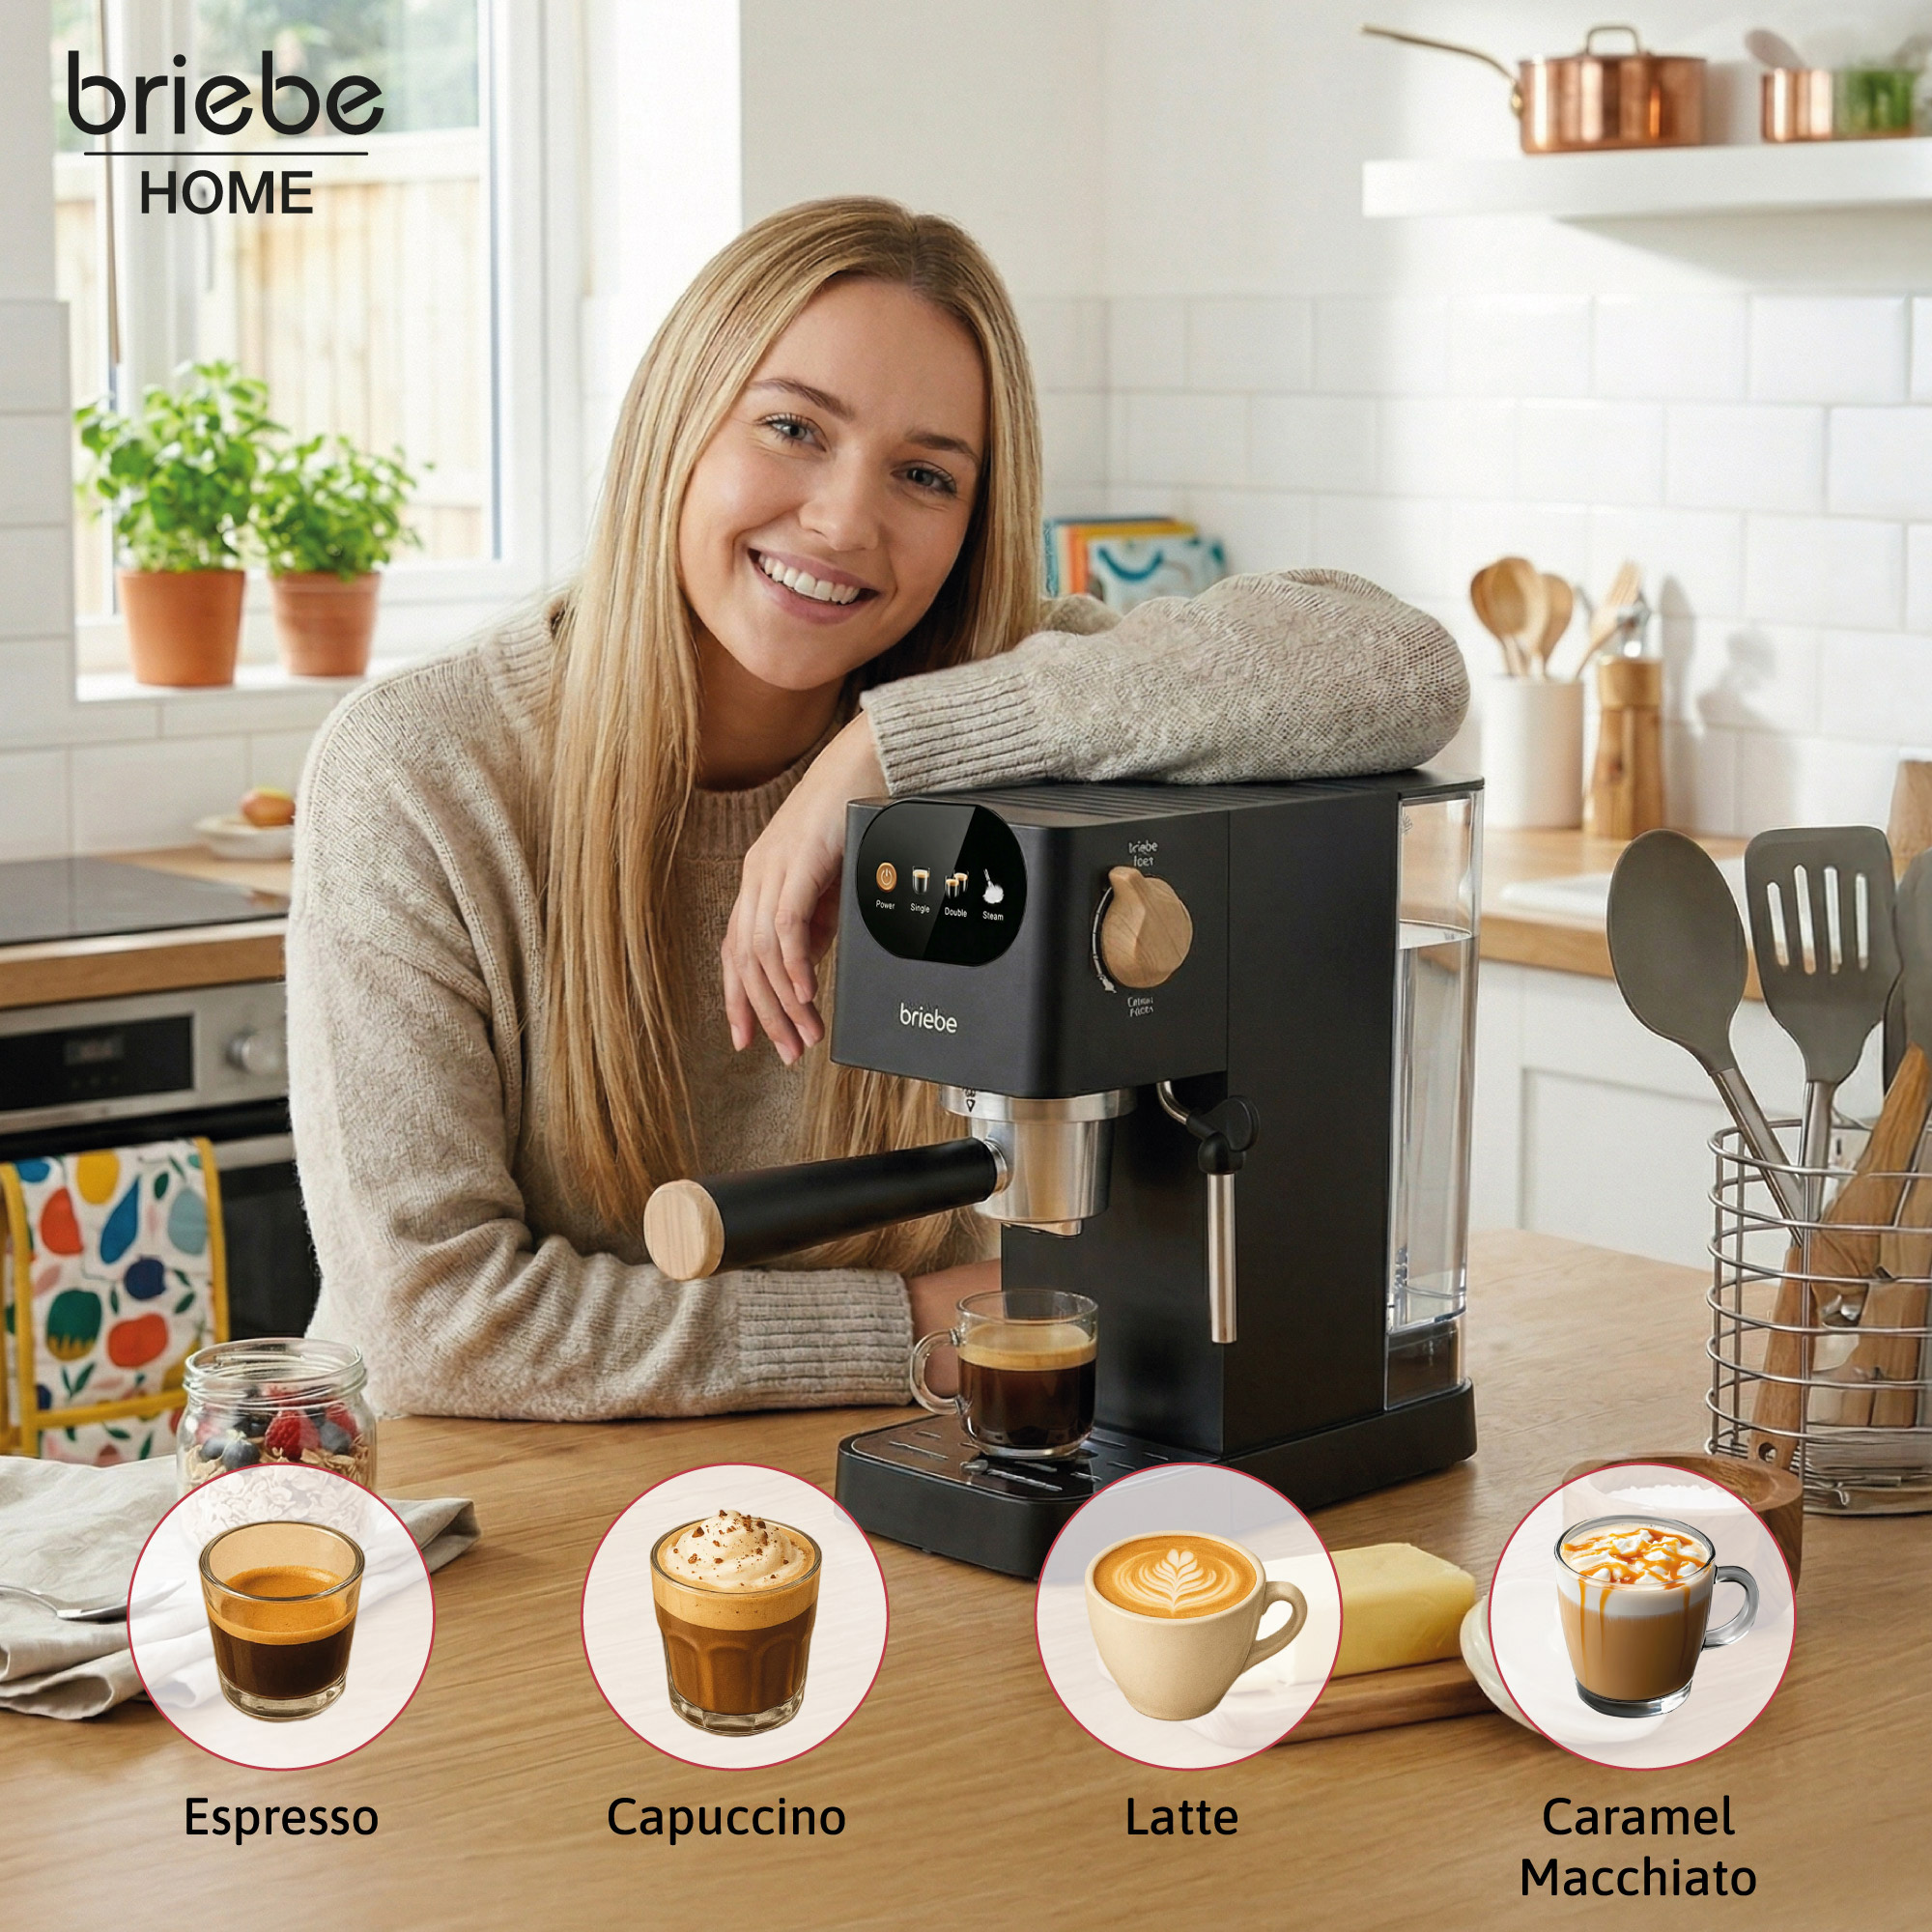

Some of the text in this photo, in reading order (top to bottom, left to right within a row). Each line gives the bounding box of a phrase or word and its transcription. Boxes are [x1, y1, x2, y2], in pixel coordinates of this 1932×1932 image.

[875, 899, 895, 910] Power
[910, 902, 930, 915] Single
[944, 906, 968, 918] Double
[982, 910, 1004, 921] Steam
[899, 1002, 958, 1034] briebe
